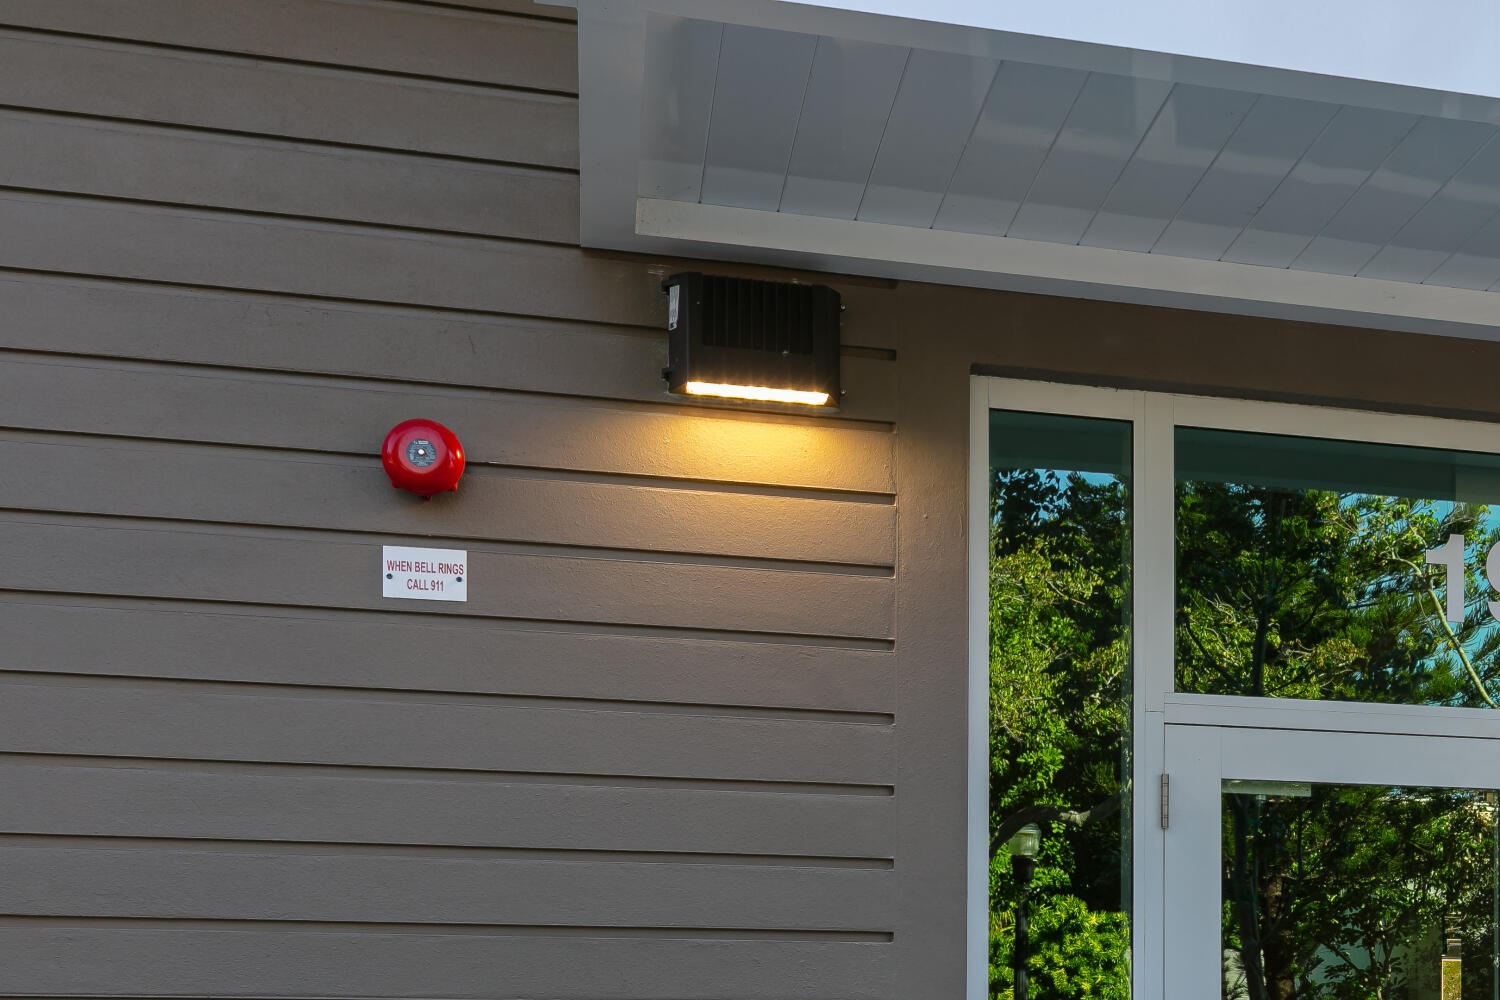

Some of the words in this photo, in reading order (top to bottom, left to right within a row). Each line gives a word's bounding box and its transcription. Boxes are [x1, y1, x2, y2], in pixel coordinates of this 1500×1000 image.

[386, 560, 412, 572] WHEN
[414, 562, 436, 573] BELL
[438, 562, 464, 575] RINGS
[406, 579, 429, 591] CALL
[430, 580, 444, 592] 911
